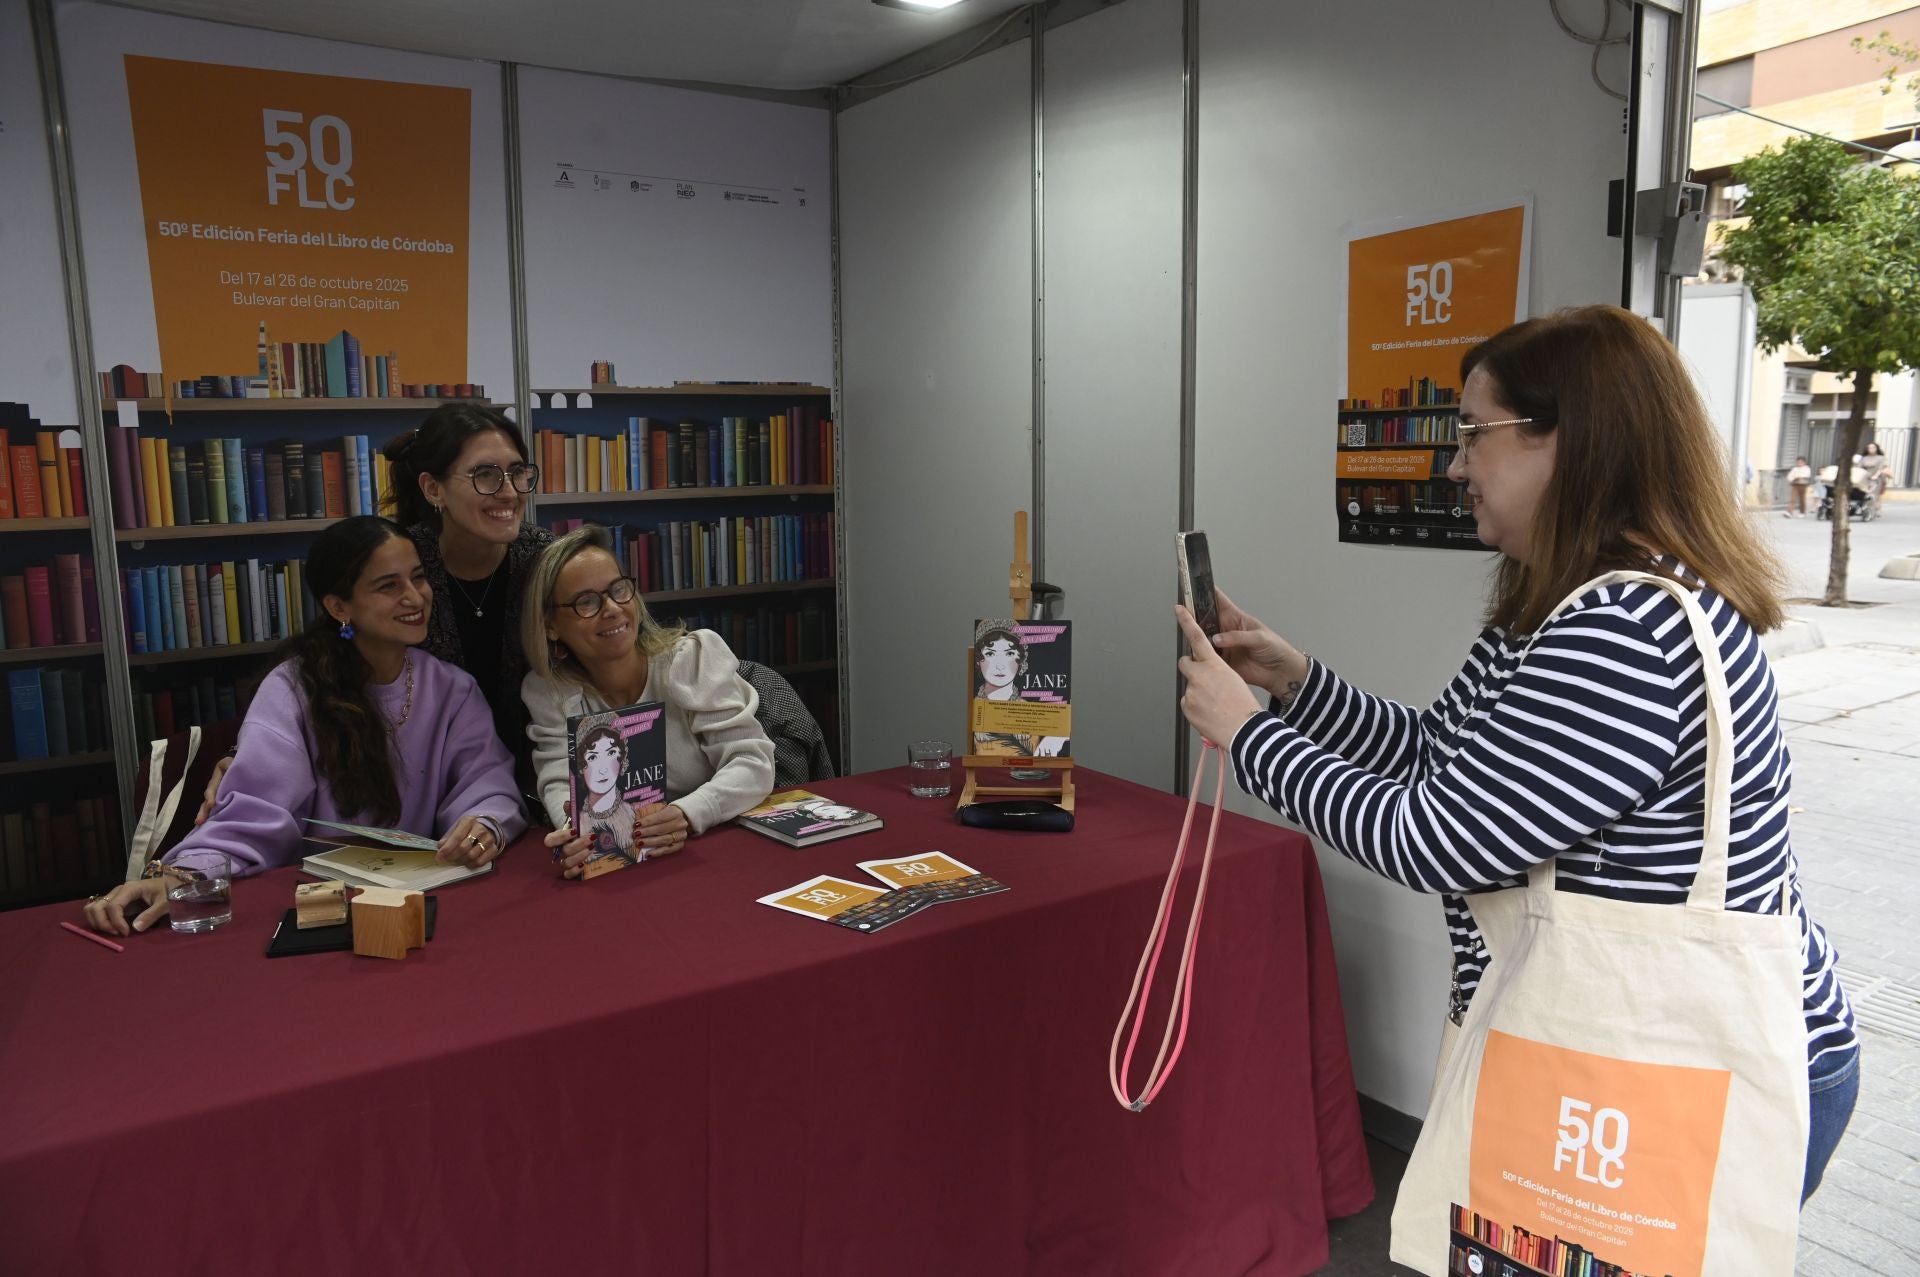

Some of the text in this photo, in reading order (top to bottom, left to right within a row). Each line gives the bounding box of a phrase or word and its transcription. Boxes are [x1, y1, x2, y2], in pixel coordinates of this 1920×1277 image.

[263, 108, 353, 175] 50
[267, 166, 355, 211] FLC
[159, 221, 454, 254] 50º Edición Feria del Libro de Córdoba
[220, 270, 408, 293] Del 17 al 26 de octubre 2025
[1407, 261, 1452, 304] 50
[233, 291, 400, 312] Bulevar del Gran Capitán
[1406, 299, 1451, 326] FLC
[1406, 340, 1421, 348] Feria
[1422, 339, 1432, 347] del
[1433, 338, 1450, 346] Libro
[1450, 337, 1460, 345] de
[1023, 674, 1067, 690] JANE
[568, 733, 576, 761] JANE
[624, 763, 664, 791] JANE
[1557, 1096, 1629, 1158] 50
[1554, 1140, 1624, 1189] FLC
[1517, 1177, 1550, 1196] Edición
[1551, 1189, 1574, 1205] Feria
[1575, 1197, 1590, 1210] del
[1591, 1201, 1619, 1218] Libro
[1619, 1210, 1633, 1222] de
[1634, 1213, 1677, 1230] Córdoba
[1536, 1198, 1548, 1208] Del
[1573, 1210, 1582, 1221] de
[1582, 1216, 1613, 1231] octubre
[1613, 1223, 1634, 1236] 2025
